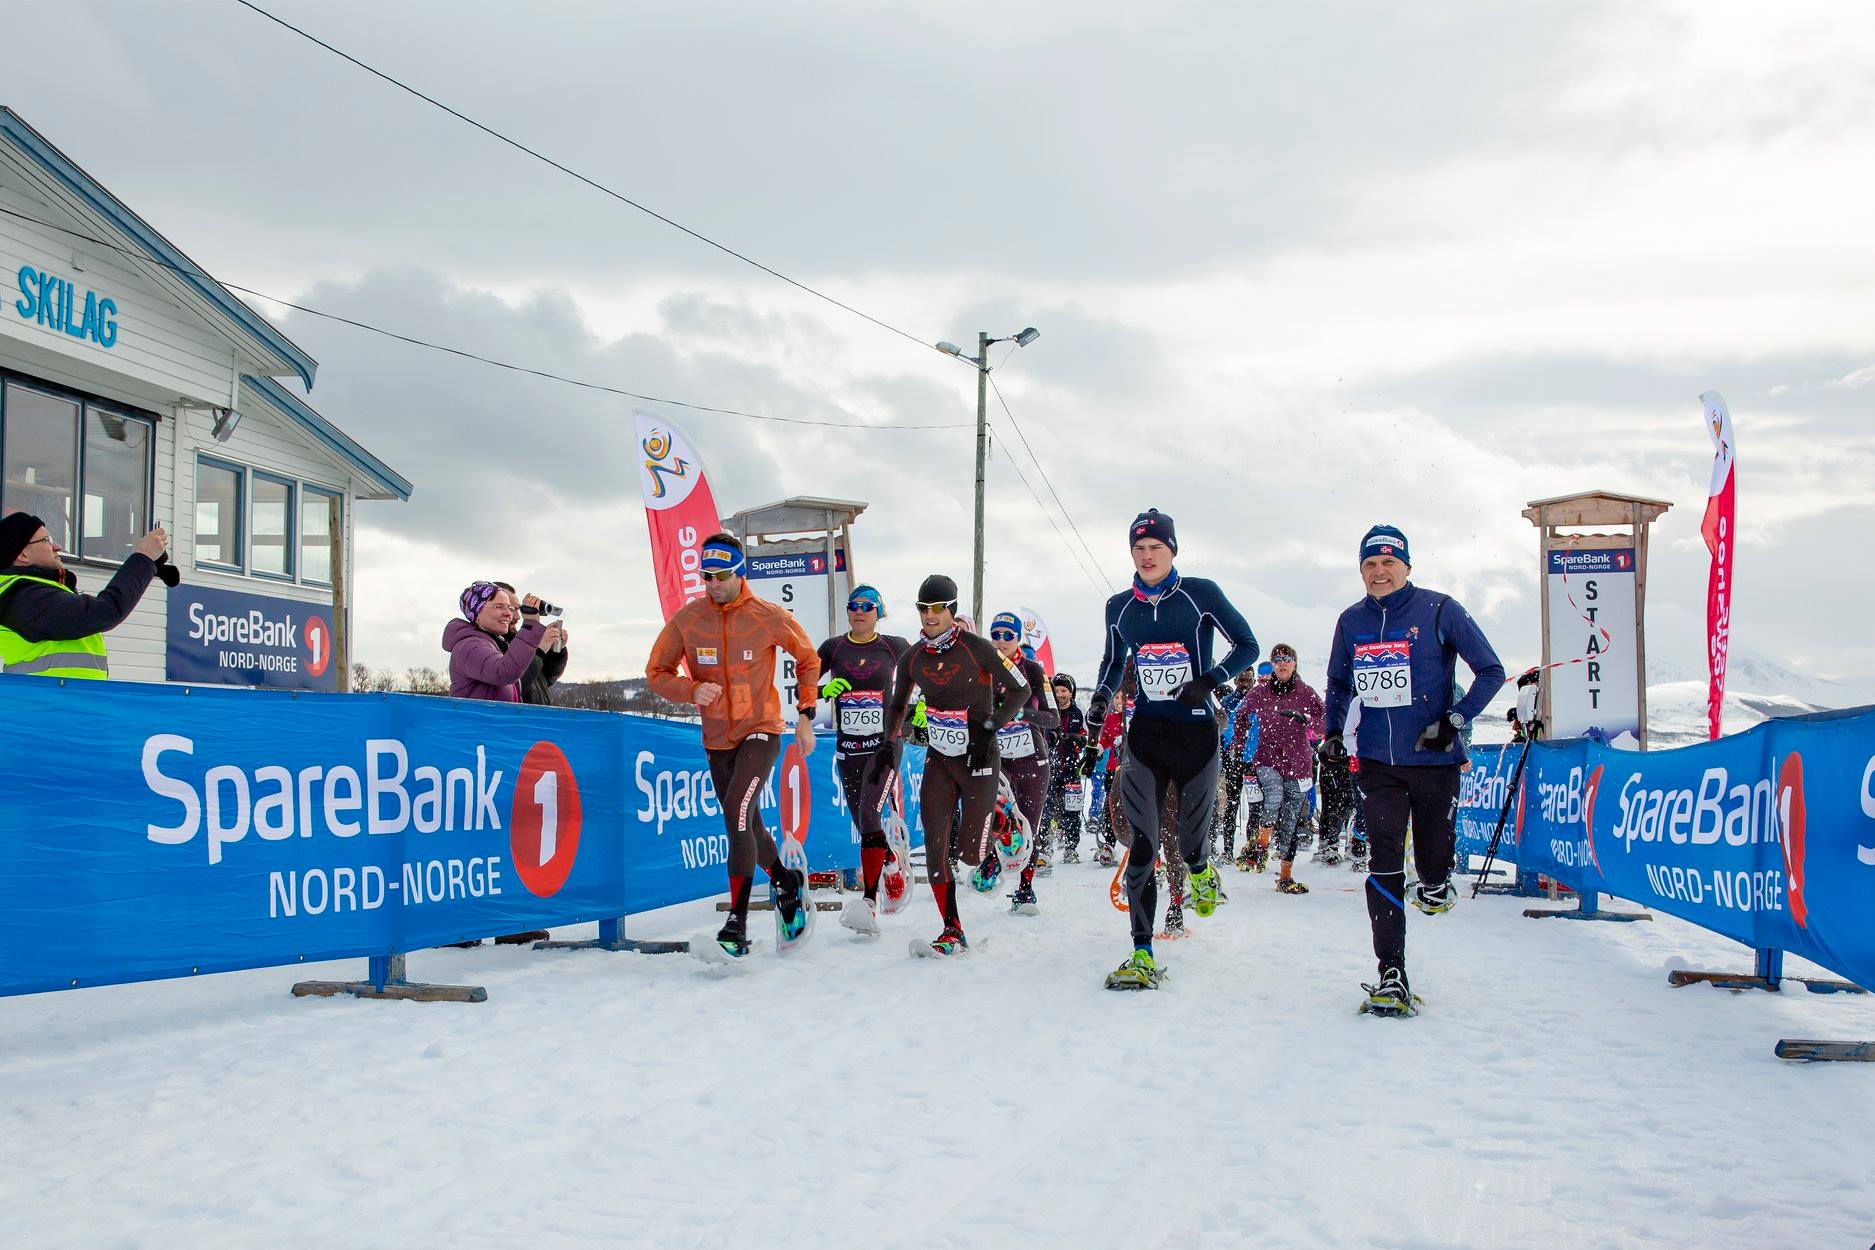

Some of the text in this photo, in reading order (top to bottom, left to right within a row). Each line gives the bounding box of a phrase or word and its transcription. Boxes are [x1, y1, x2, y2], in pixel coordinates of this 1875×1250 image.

[16, 265, 117, 348] SKILAG
[752, 558, 806, 571] SpareBank
[1553, 553, 1610, 566] SpareBank
[188, 602, 297, 648] SpareBank
[1585, 580, 1602, 709] START
[219, 651, 298, 673] NORD-NORGE
[1142, 667, 1188, 685] 8767
[1357, 670, 1408, 691] 8786
[843, 710, 881, 725] 8768
[862, 738, 880, 749] MAX
[929, 725, 966, 745] 8769
[140, 733, 504, 866] SpareBank
[1612, 755, 1781, 854] SpareBank
[269, 856, 502, 918] NORD-NORGE
[1646, 863, 1782, 912] NORD-NORGE
